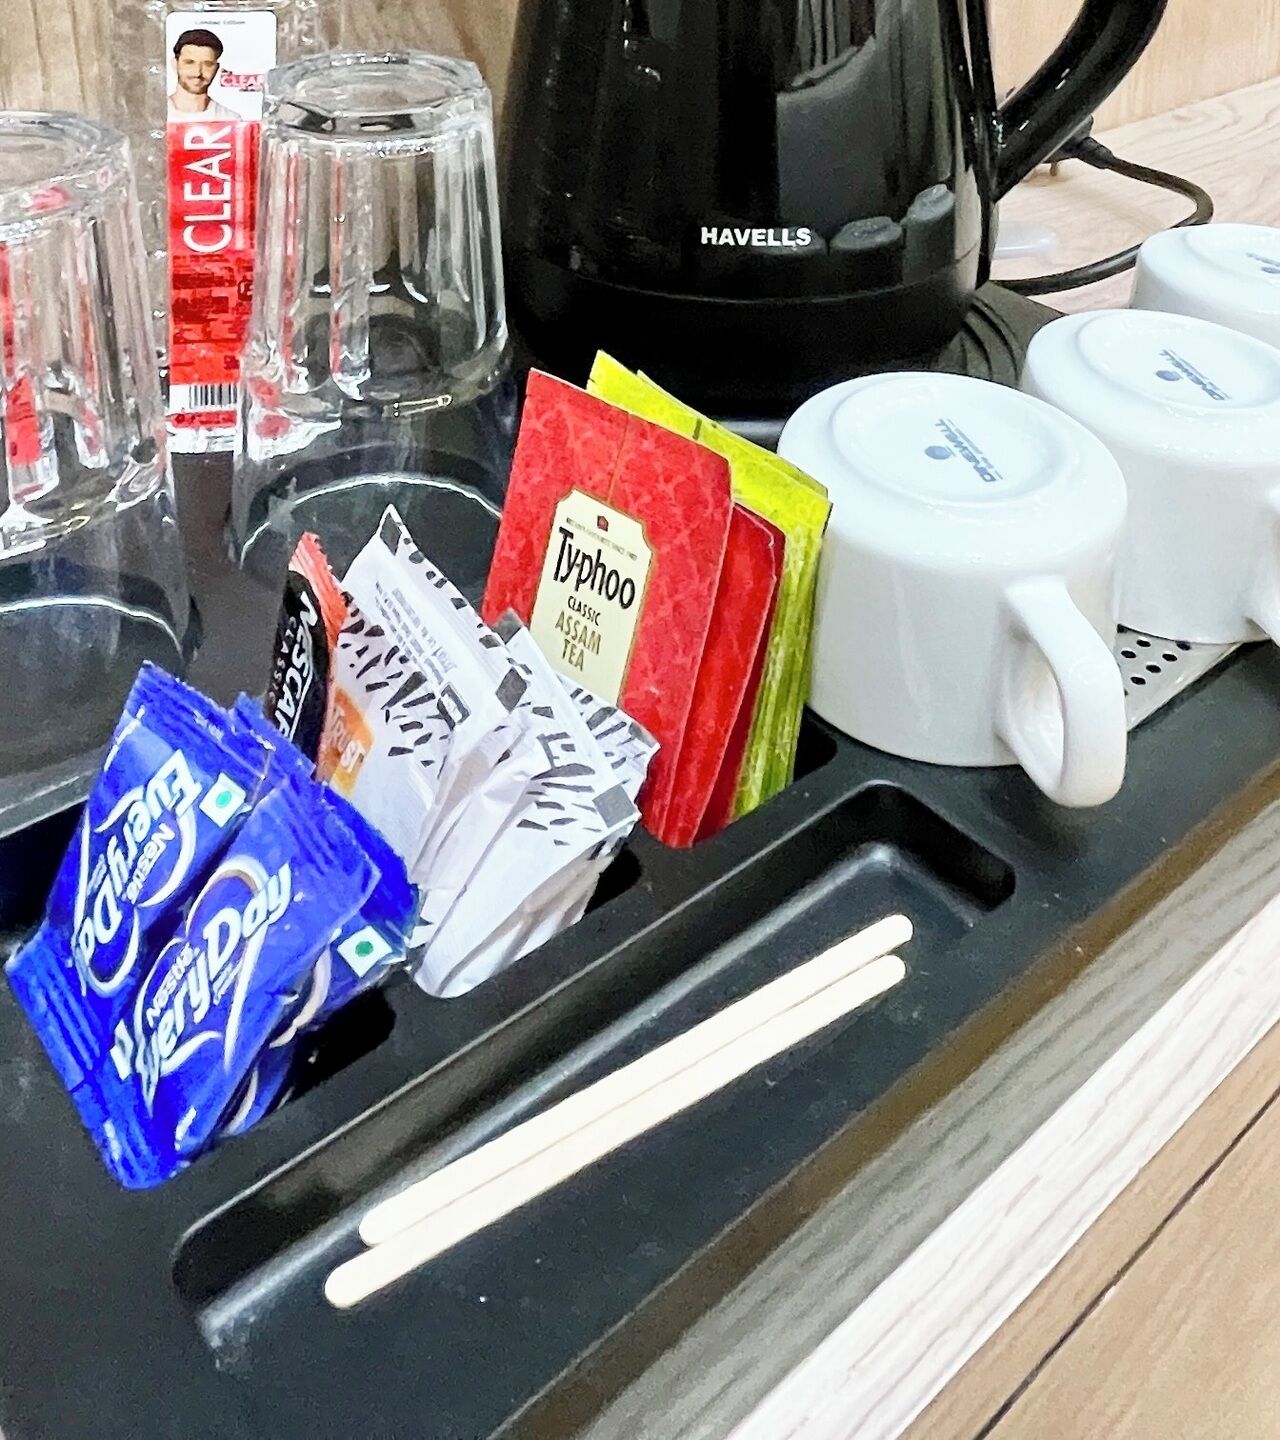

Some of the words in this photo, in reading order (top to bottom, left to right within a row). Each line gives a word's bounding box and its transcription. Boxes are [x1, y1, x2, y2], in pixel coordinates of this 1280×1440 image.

[183, 124, 233, 254] CLEAR
[701, 226, 812, 247] HAVELLS
[567, 595, 602, 627] CLASSIC
[555, 610, 602, 656] ASSAM
[275, 591, 318, 738] NESCAF
[561, 638, 585, 672] TEA
